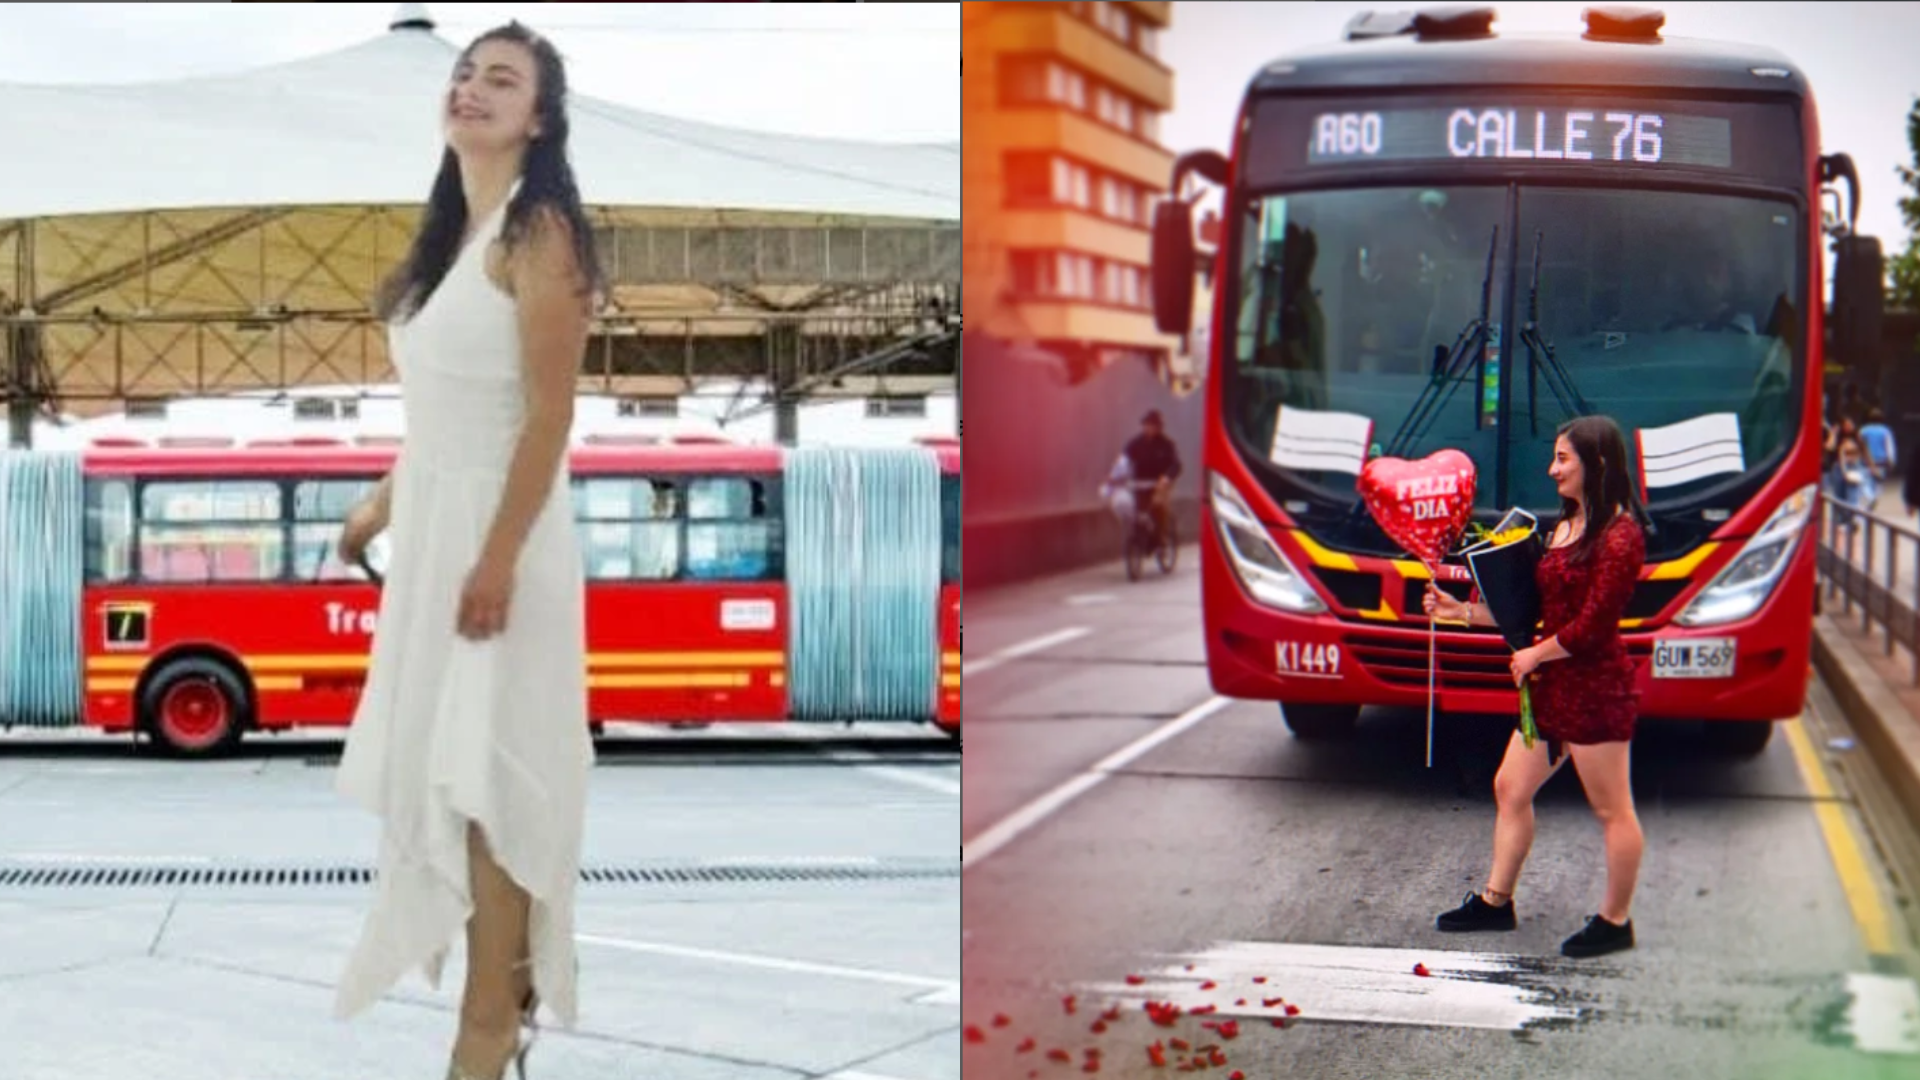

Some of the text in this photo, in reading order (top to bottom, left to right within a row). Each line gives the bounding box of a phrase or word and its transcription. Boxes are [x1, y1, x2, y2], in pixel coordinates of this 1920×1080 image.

[1317, 108, 1663, 162] A60 CALLE 76
[1396, 474, 1459, 502] FELIZ
[1413, 498, 1450, 520] DIA
[1275, 640, 1340, 674] K1449
[1696, 644, 1734, 668] 569
